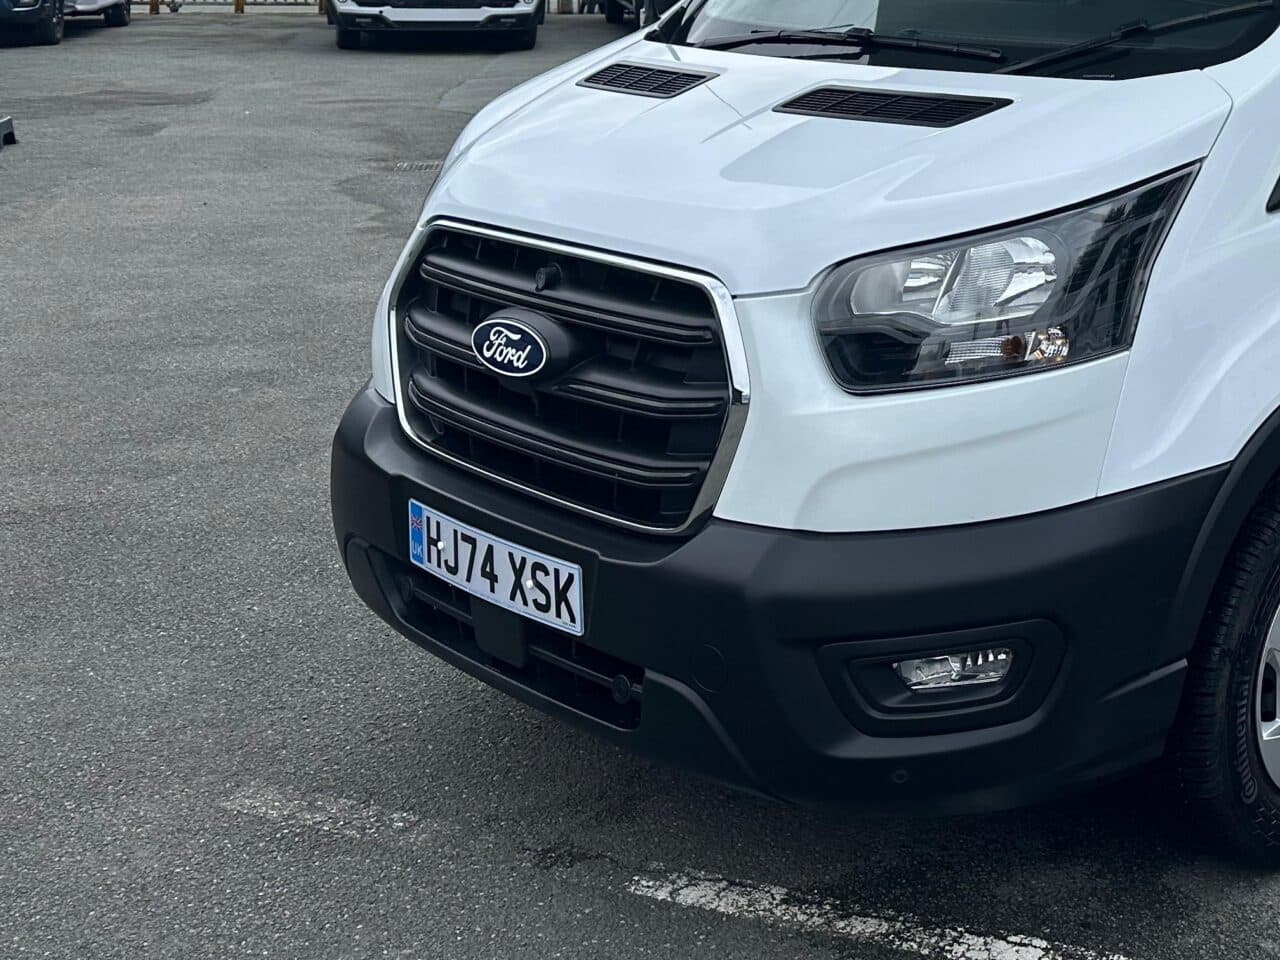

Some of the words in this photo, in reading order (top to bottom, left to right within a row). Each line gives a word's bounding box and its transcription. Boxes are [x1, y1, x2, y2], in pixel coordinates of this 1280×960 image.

[483, 326, 531, 368] Ford
[411, 540, 424, 558] UK
[426, 516, 499, 594] HJ74
[507, 551, 576, 625] XSK
